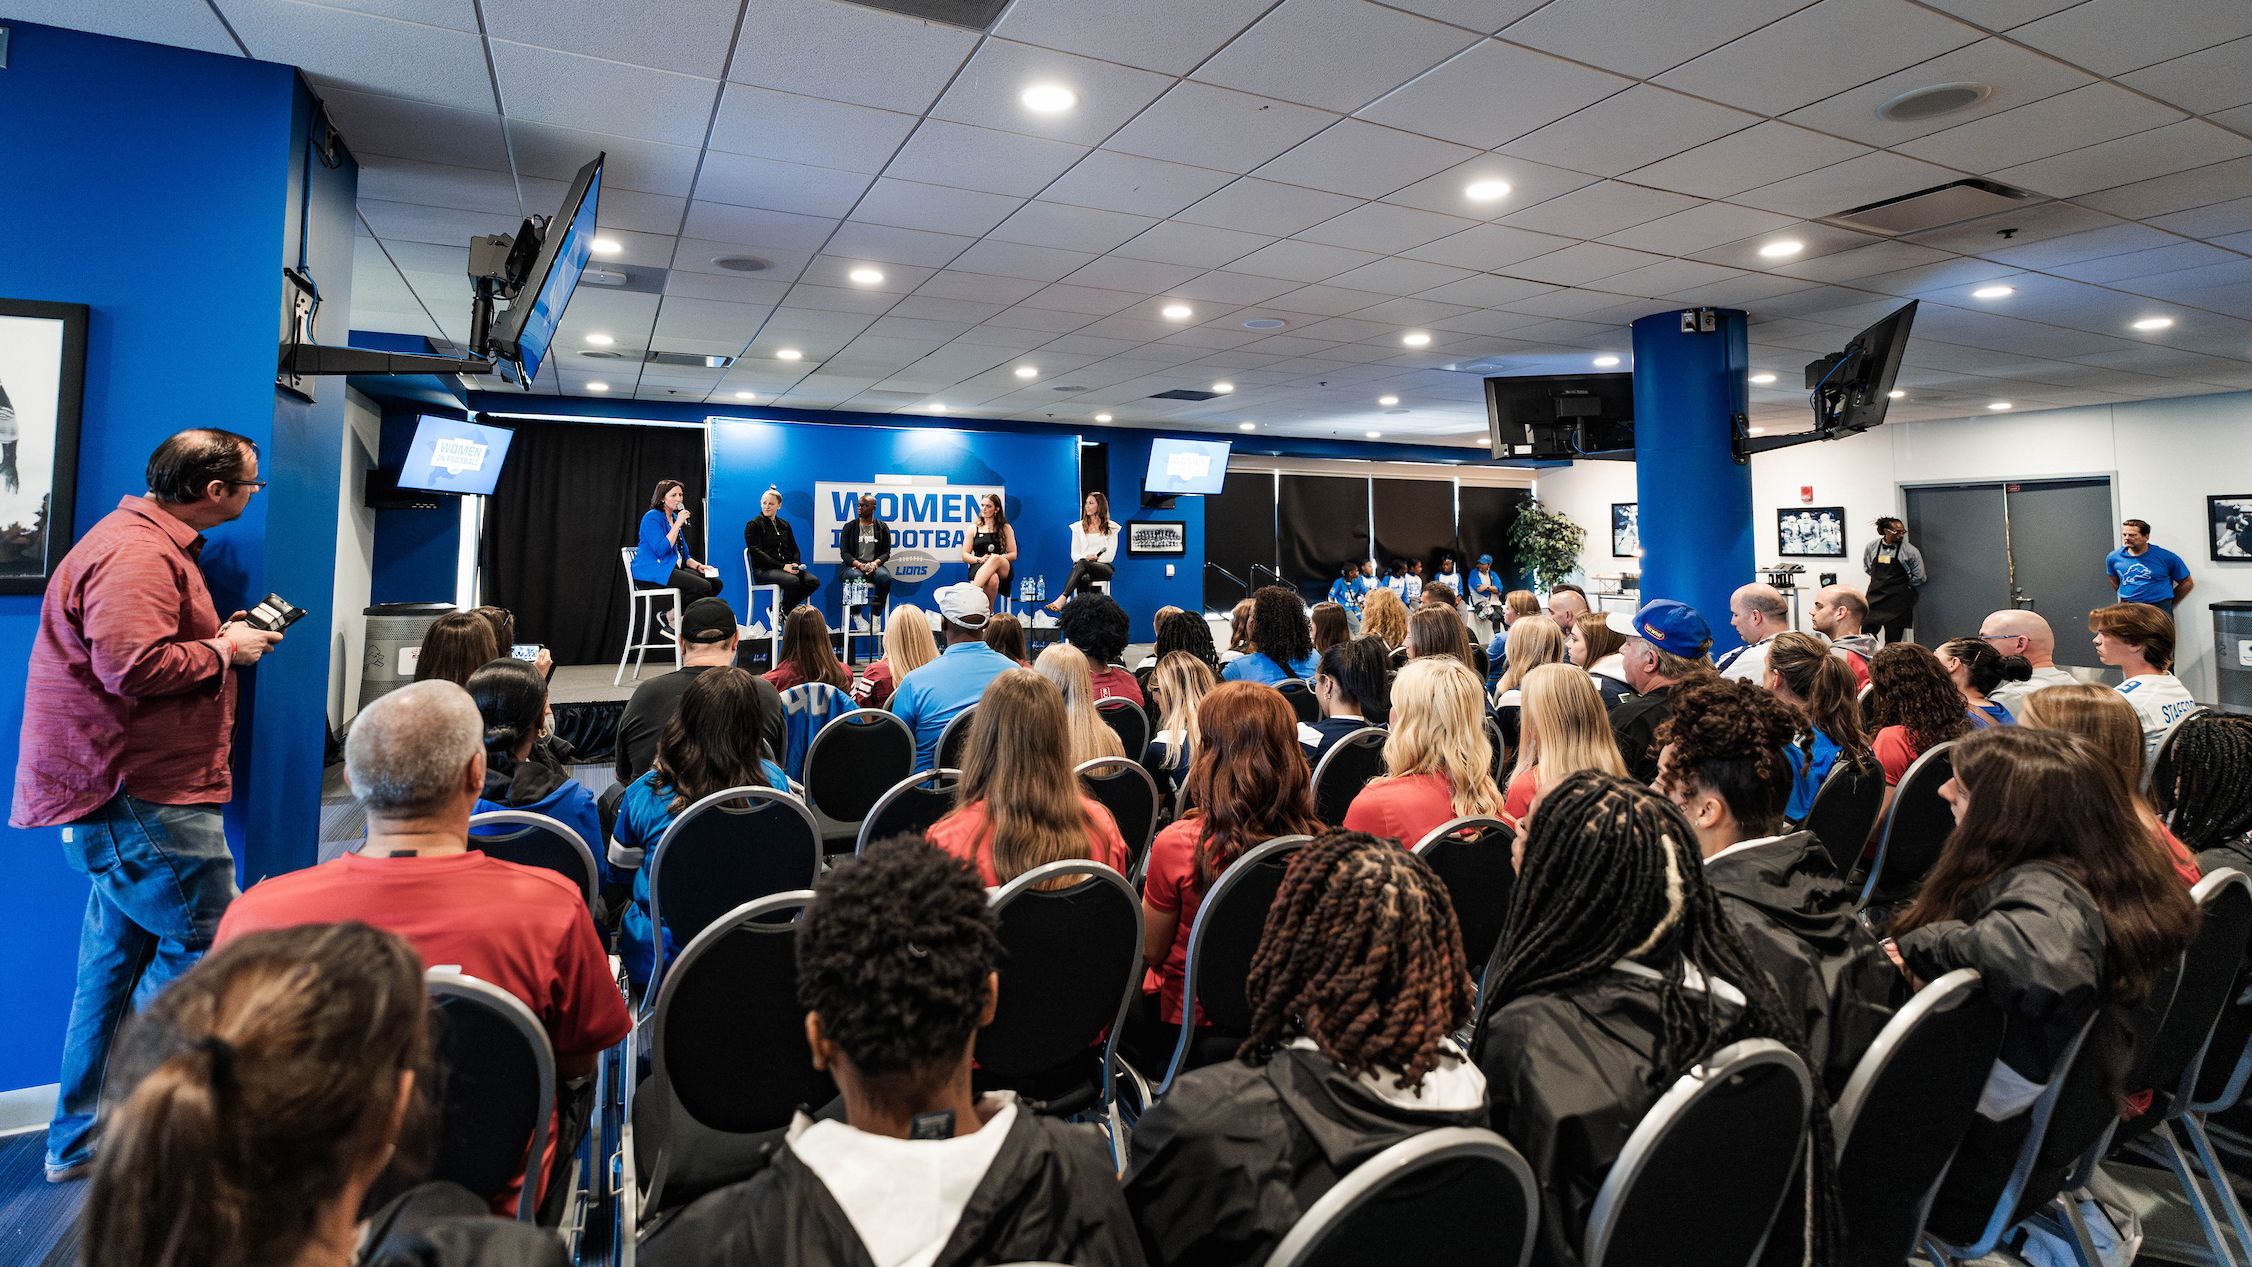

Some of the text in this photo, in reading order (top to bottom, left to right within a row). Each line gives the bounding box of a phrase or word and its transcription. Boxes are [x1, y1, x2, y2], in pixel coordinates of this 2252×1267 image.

[440, 441, 482, 457] WOMEN
[889, 529, 965, 549] OOTBA
[895, 565, 928, 576] LIONS
